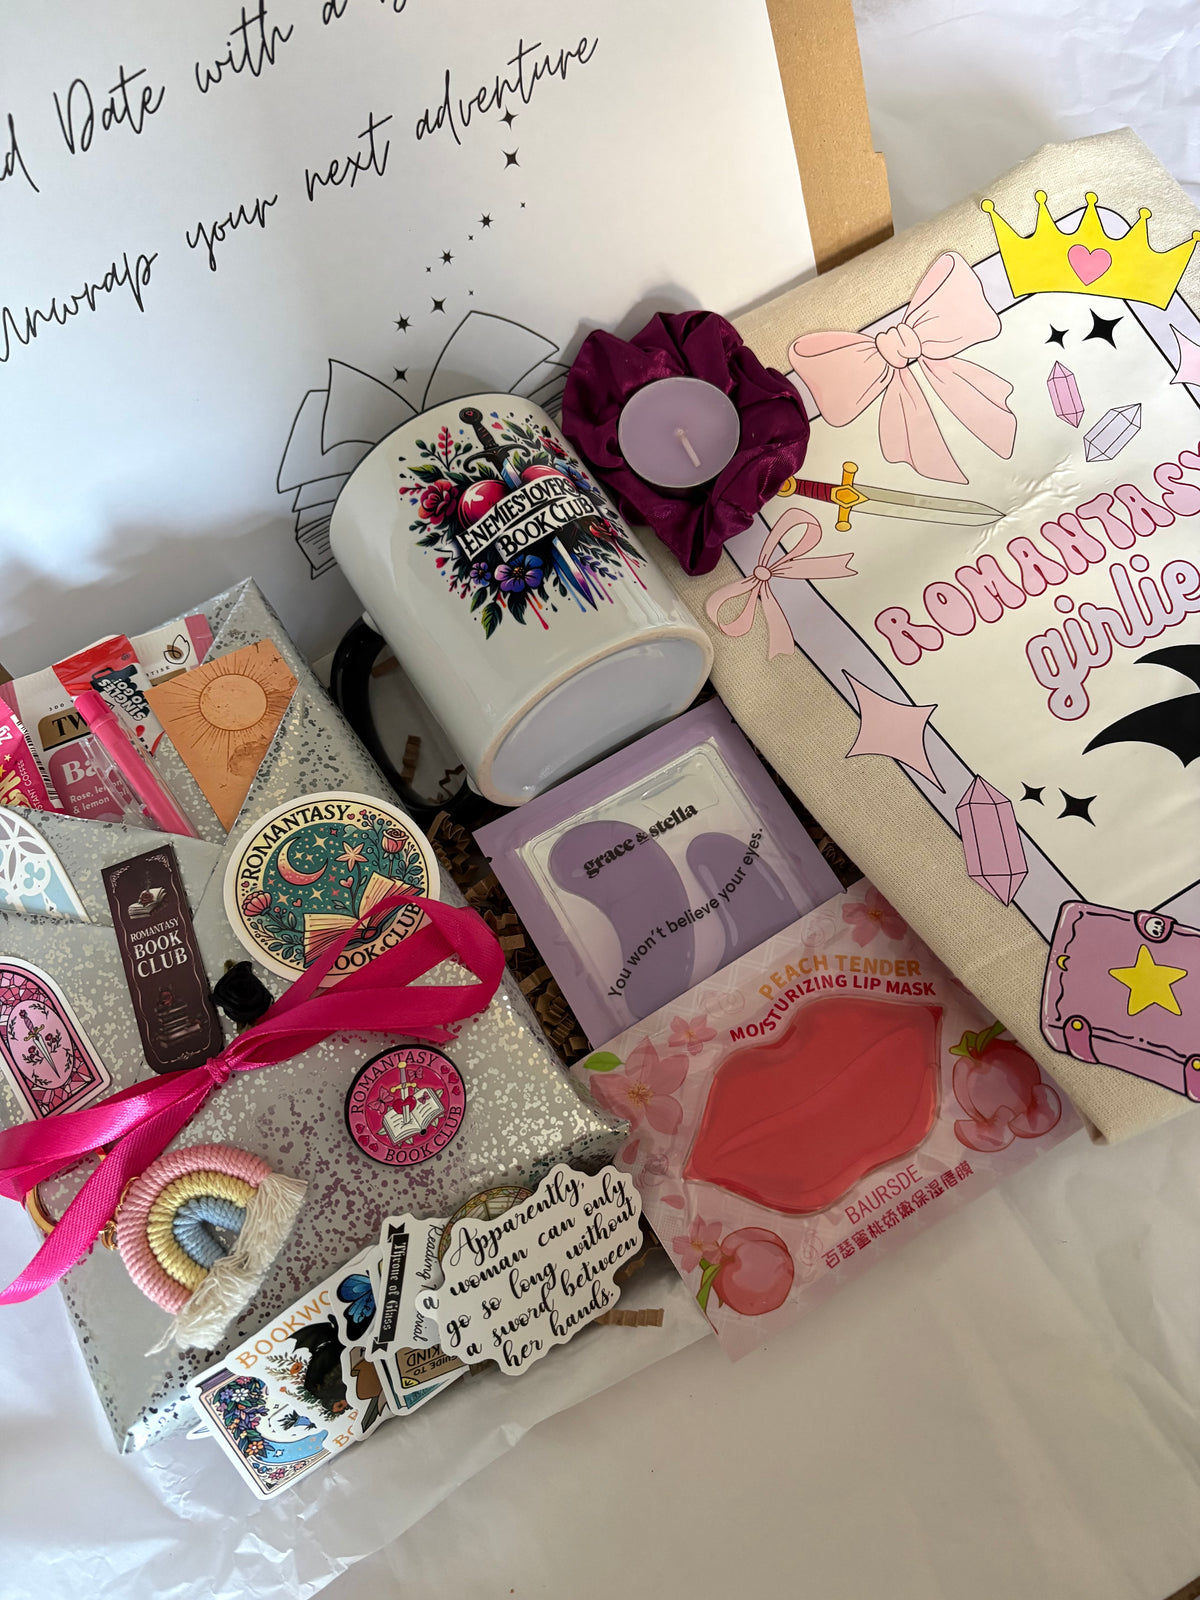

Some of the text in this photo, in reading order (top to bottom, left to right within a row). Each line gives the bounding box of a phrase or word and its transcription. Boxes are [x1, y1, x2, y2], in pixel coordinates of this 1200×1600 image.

[53, 65, 164, 155] Date
[196, 0, 294, 94] with
[186, 194, 278, 272] your
[305, 112, 393, 202] next
[416, 37, 599, 146] adventure
[458, 494, 526, 556] ENEMIES
[524, 477, 580, 508] LOVERS
[500, 497, 595, 557] BOOK CLUB
[1025, 554, 1200, 721] girlie
[98, 679, 148, 721] SINGLES
[18, 760, 32, 786] COFFEE
[70, 791, 94, 804] Rose,
[82, 796, 110, 810] lemon
[241, 804, 351, 882] ROMANTASY
[583, 802, 698, 879] grace & stella
[130, 917, 179, 942] ROMANTASY
[133, 929, 183, 960] BOOK
[327, 902, 422, 972] OOK CLUB
[608, 967, 632, 997] You
[666, 898, 720, 933] believe
[718, 867, 747, 902] your
[743, 828, 763, 866] eyes.
[137, 947, 188, 978] CLUB
[758, 954, 922, 1000] PEACH TENDER
[729, 974, 937, 1042] MOISTURIZING LIP MASK
[351, 1051, 439, 1114] ROMANTASY
[384, 1106, 462, 1163] BOOK CLUB
[450, 1171, 585, 1267] Apparently,
[844, 1164, 924, 1225] BAURSDE
[450, 1248, 528, 1296] woman
[538, 1217, 576, 1247] can
[583, 1172, 627, 1217] only
[446, 1195, 637, 1348] go so long without
[466, 1236, 639, 1357] a sword between
[503, 1280, 614, 1367] her hands.
